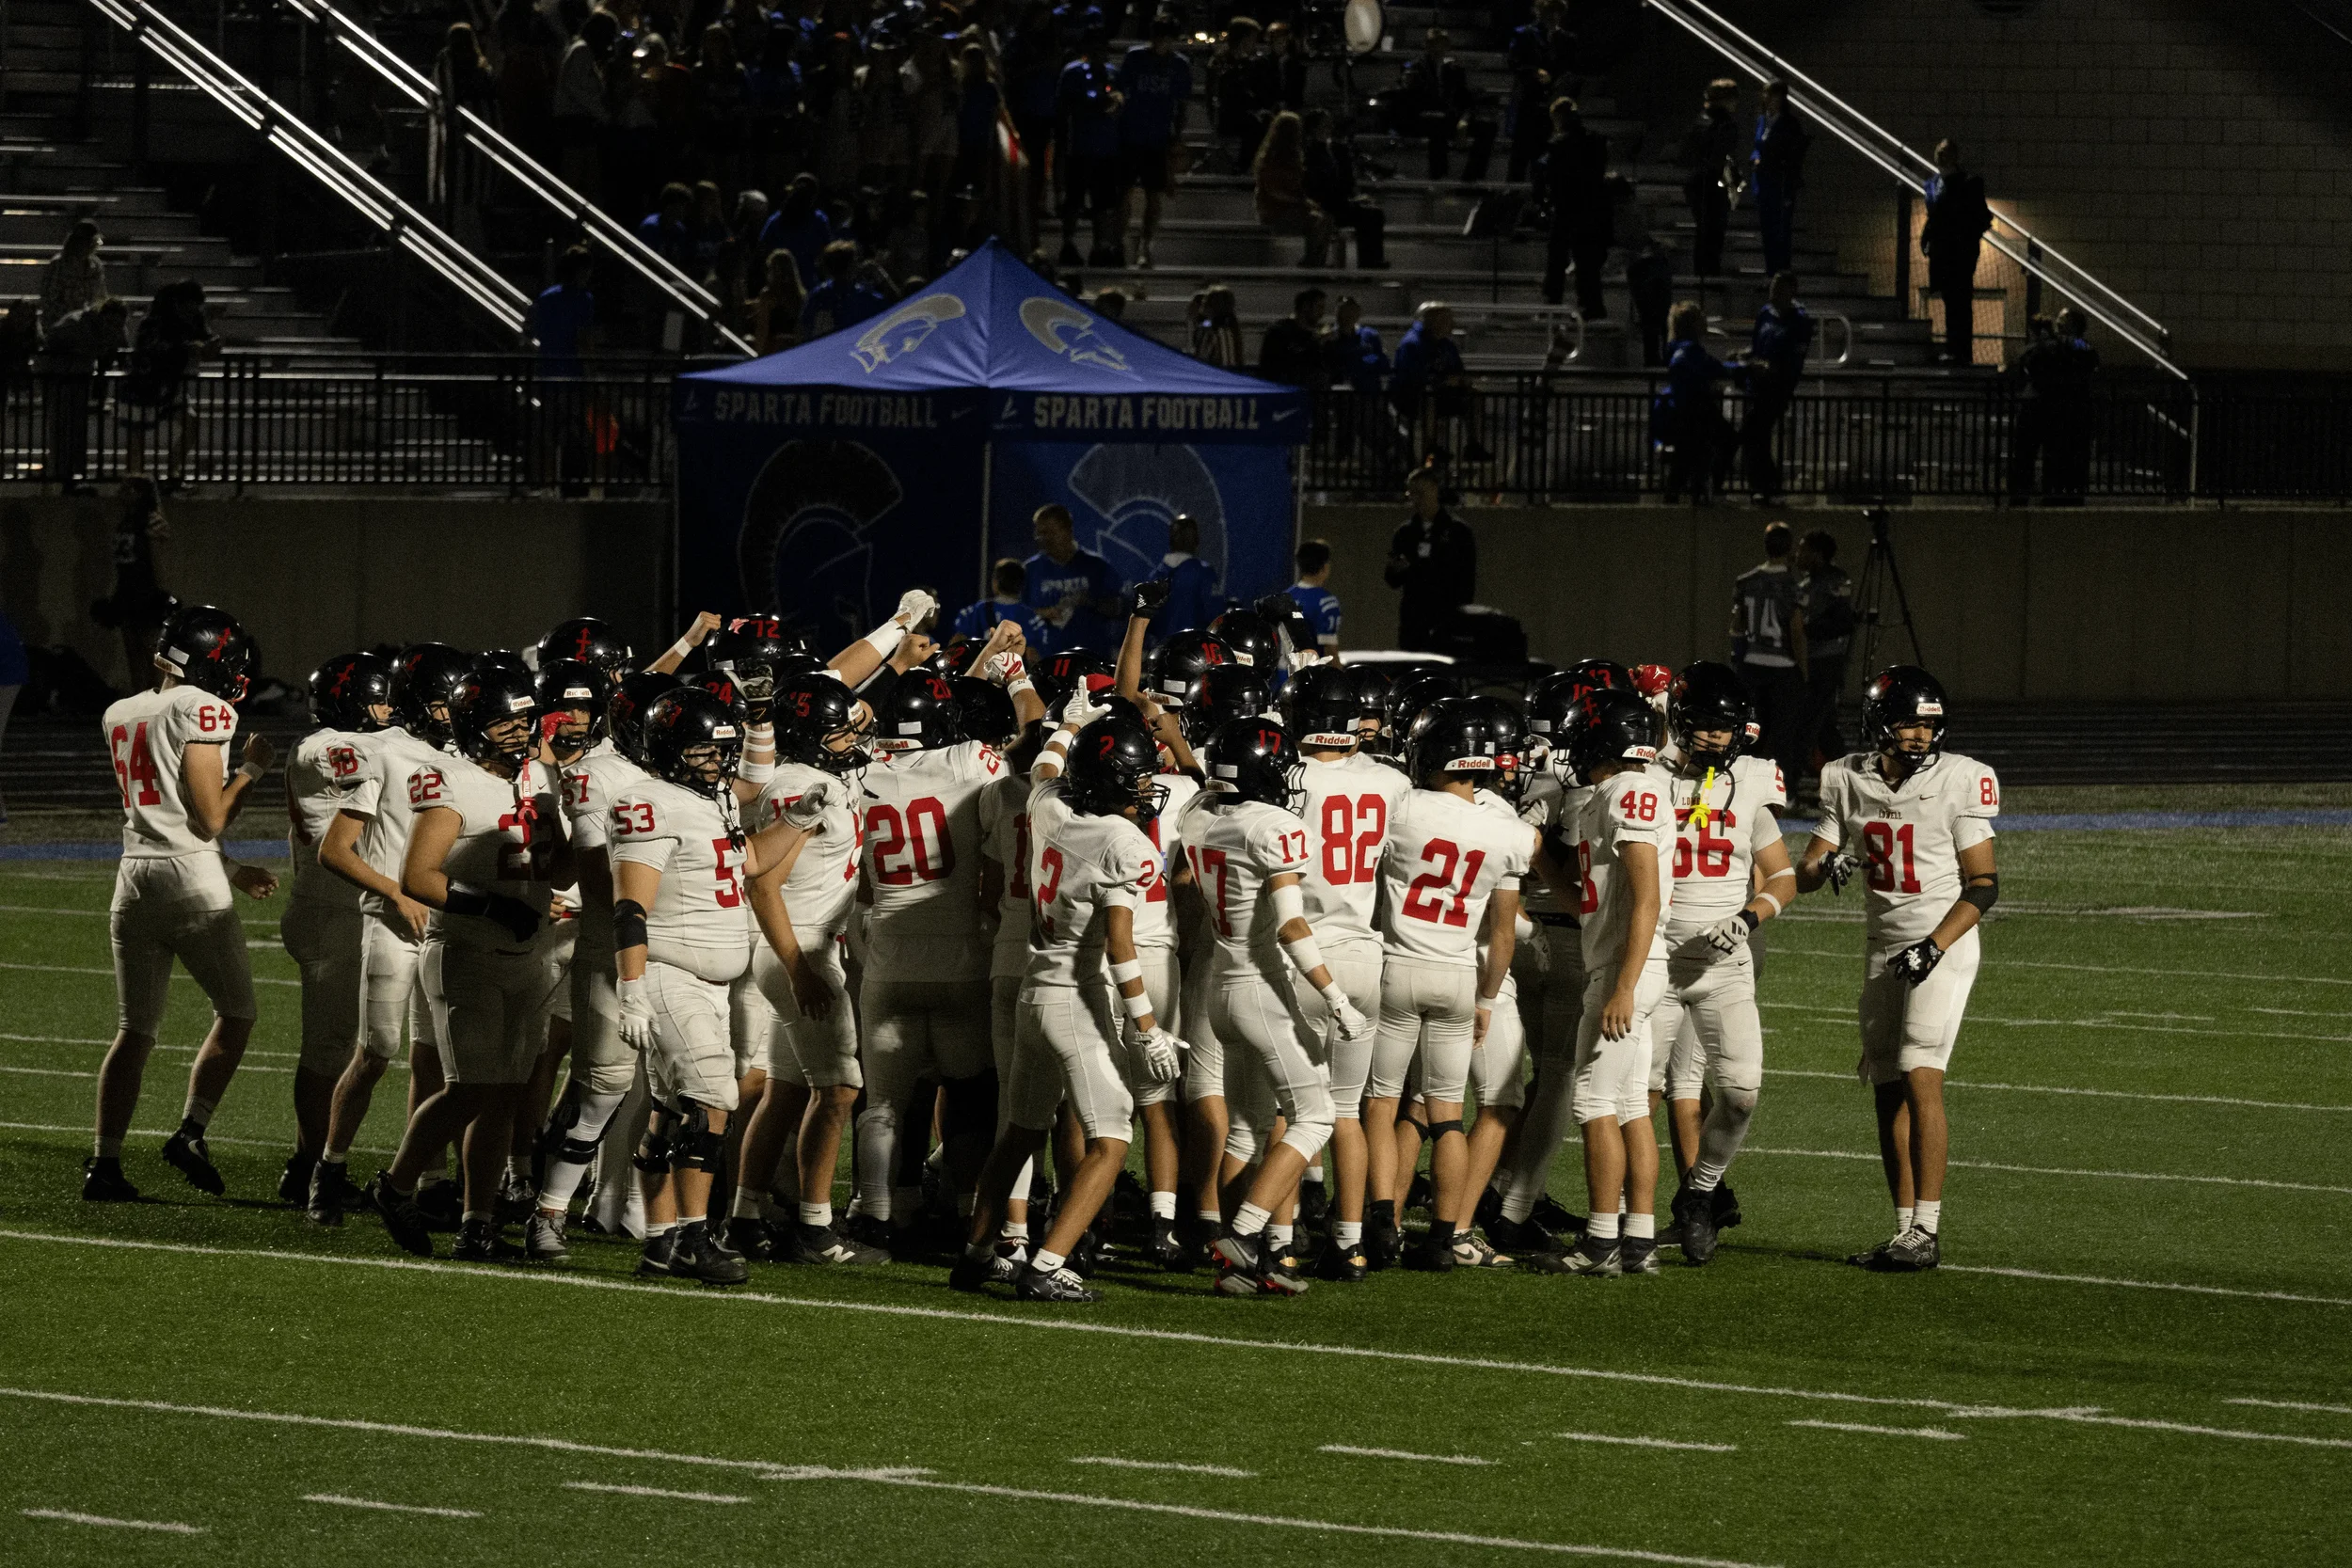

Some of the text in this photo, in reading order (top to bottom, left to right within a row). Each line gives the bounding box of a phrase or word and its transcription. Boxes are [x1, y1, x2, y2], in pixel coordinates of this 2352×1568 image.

[714, 390, 938, 428] SPARTA FOOTBALL
[1034, 396, 1260, 430] SPARTA FOOTBALL
[750, 619, 782, 640] 72
[1743, 595, 1783, 648] 14
[1053, 657, 1072, 677] 11
[199, 705, 233, 733] 64
[1258, 728, 1282, 755] 17
[1314, 734, 1351, 745] Riddell
[111, 721, 161, 808] 64
[1457, 758, 1491, 769] Riddell
[409, 773, 443, 803] 22
[613, 802, 656, 835] 53
[1619, 790, 1659, 822] 48
[1879, 810, 1903, 820] LOWELL
[866, 796, 956, 885] 20
[1278, 829, 1310, 864] 17
[1321, 793, 1387, 886] 82
[711, 837, 746, 909] 5
[1136, 859, 1155, 887] 2
[1863, 821, 1922, 895] 81
[1187, 845, 1232, 938] 17
[1401, 837, 1486, 928] 21
